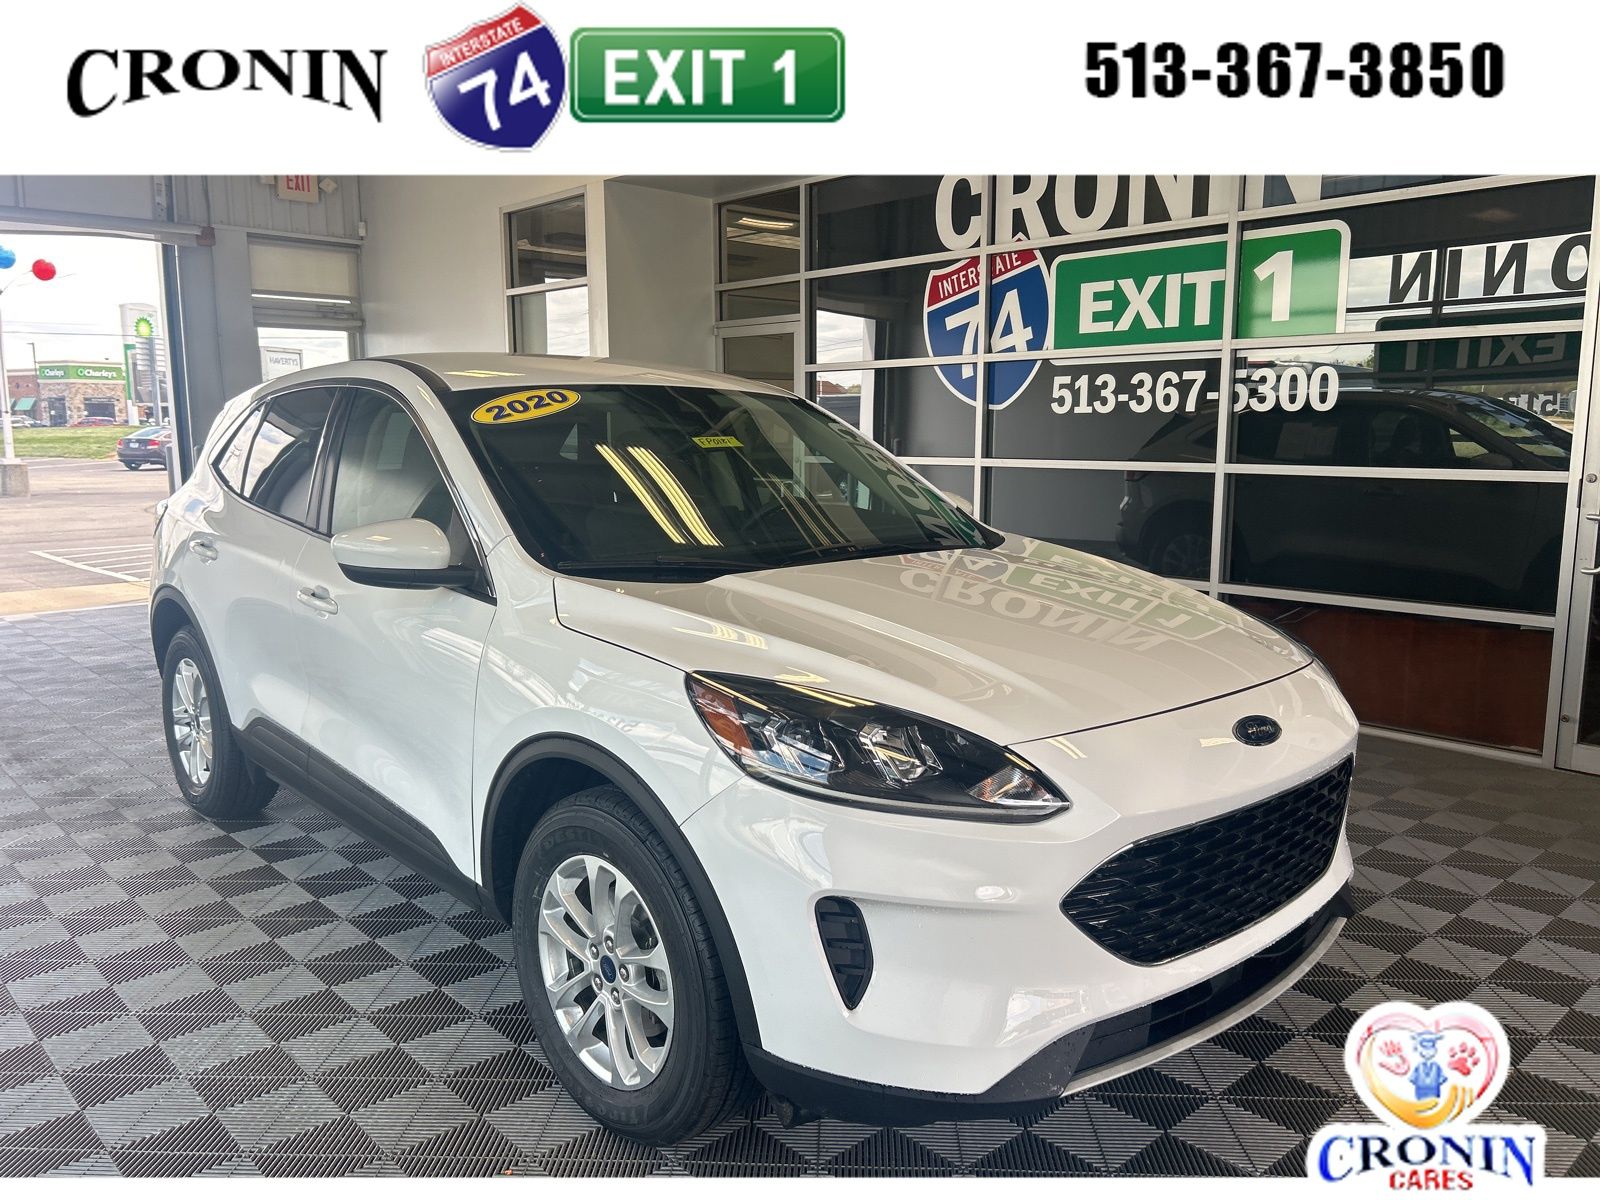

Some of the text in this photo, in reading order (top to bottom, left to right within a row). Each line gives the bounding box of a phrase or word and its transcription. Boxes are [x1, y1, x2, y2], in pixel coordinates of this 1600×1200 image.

[938, 253, 1022, 299] INTERATE
[1079, 250, 1294, 334] EXIT 1
[945, 289, 1034, 380] 74
[485, 391, 570, 421] 2020
